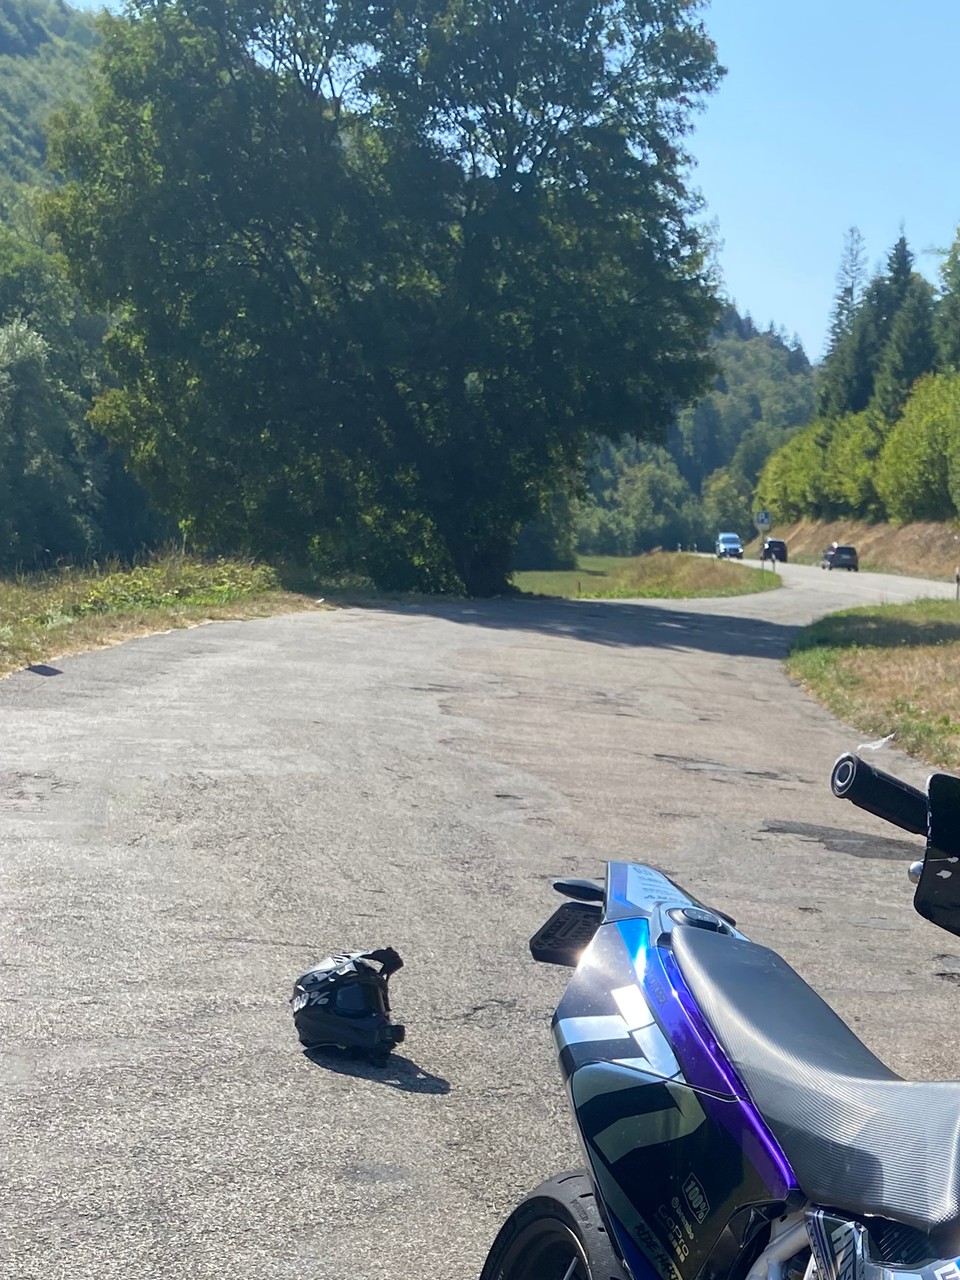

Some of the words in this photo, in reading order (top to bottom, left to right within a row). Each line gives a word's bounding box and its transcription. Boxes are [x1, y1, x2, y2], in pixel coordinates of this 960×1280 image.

[685, 1180, 709, 1220] 100%
[634, 1222, 659, 1252] RIDE
[657, 1204, 690, 1258] GoPro
